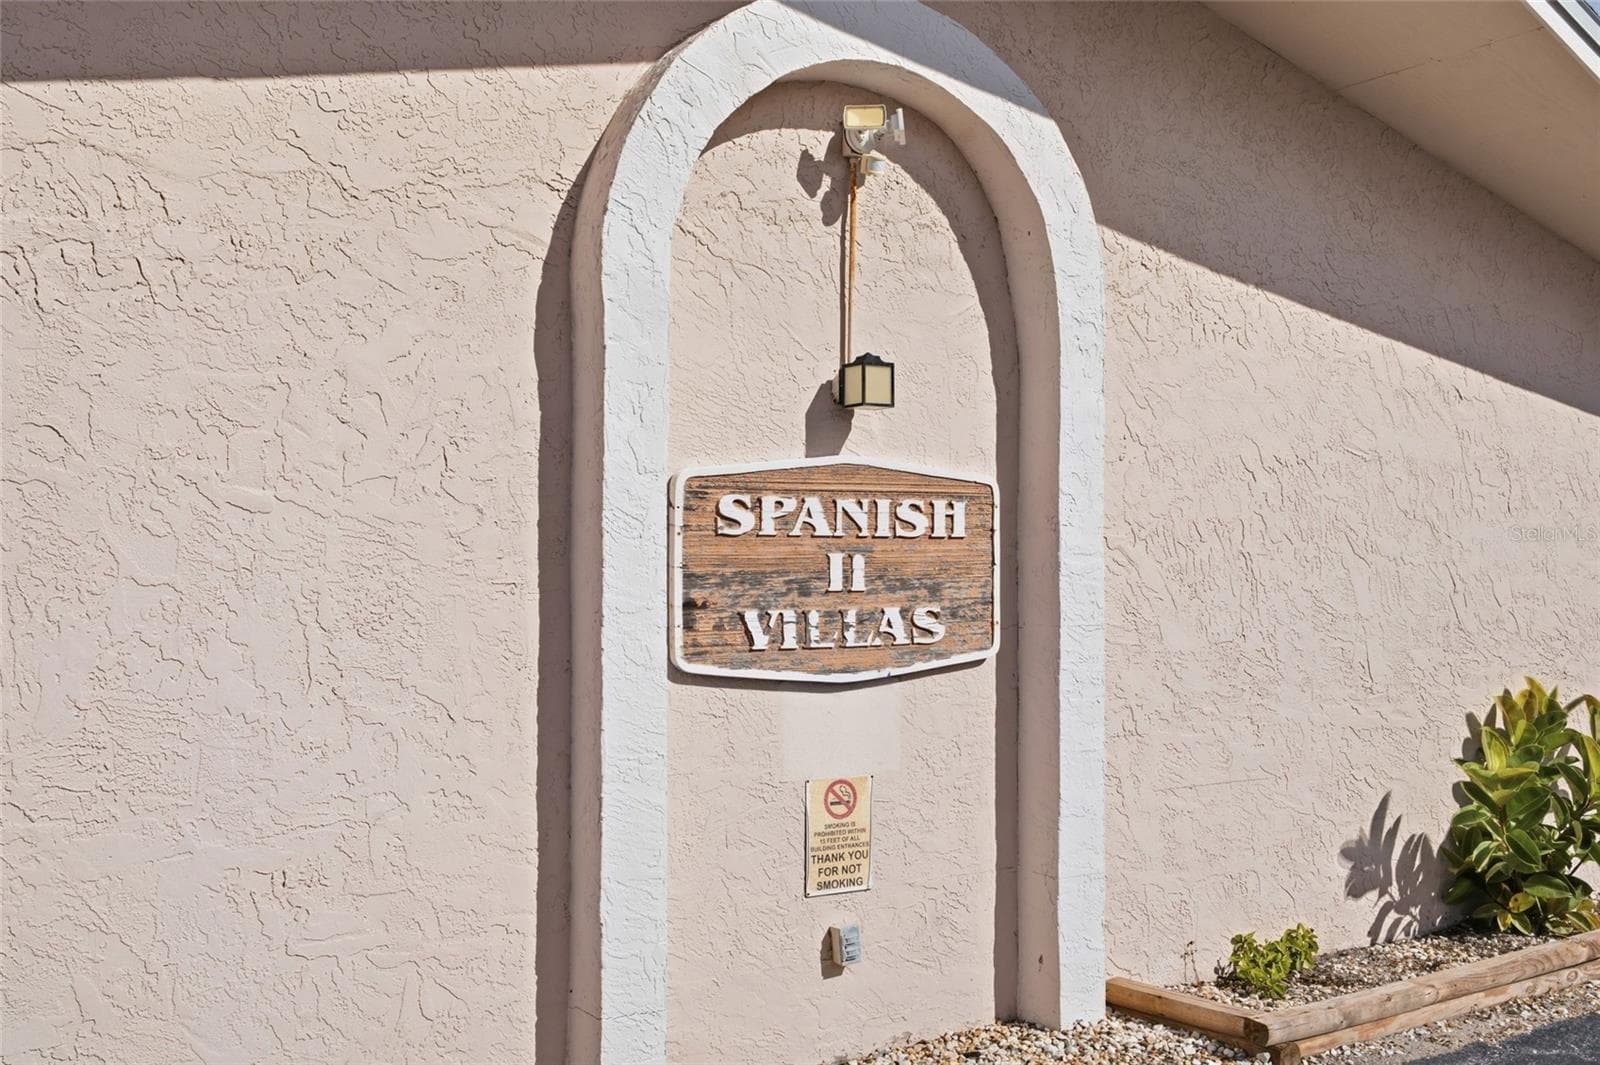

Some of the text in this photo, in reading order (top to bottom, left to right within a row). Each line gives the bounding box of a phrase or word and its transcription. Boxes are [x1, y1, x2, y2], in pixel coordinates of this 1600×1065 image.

[715, 494, 968, 538] SPANISH
[826, 551, 866, 592] II
[740, 606, 946, 651] VILLAS
[824, 822, 849, 830] SMOKING
[814, 829, 847, 838] PROHIBITED
[826, 836, 841, 844] FEET
[811, 841, 869, 853] BUILDING ENTRANCES
[811, 850, 868, 865] THANK YOU
[818, 863, 862, 877] FOR NOT
[816, 877, 863, 891] SMOKING
